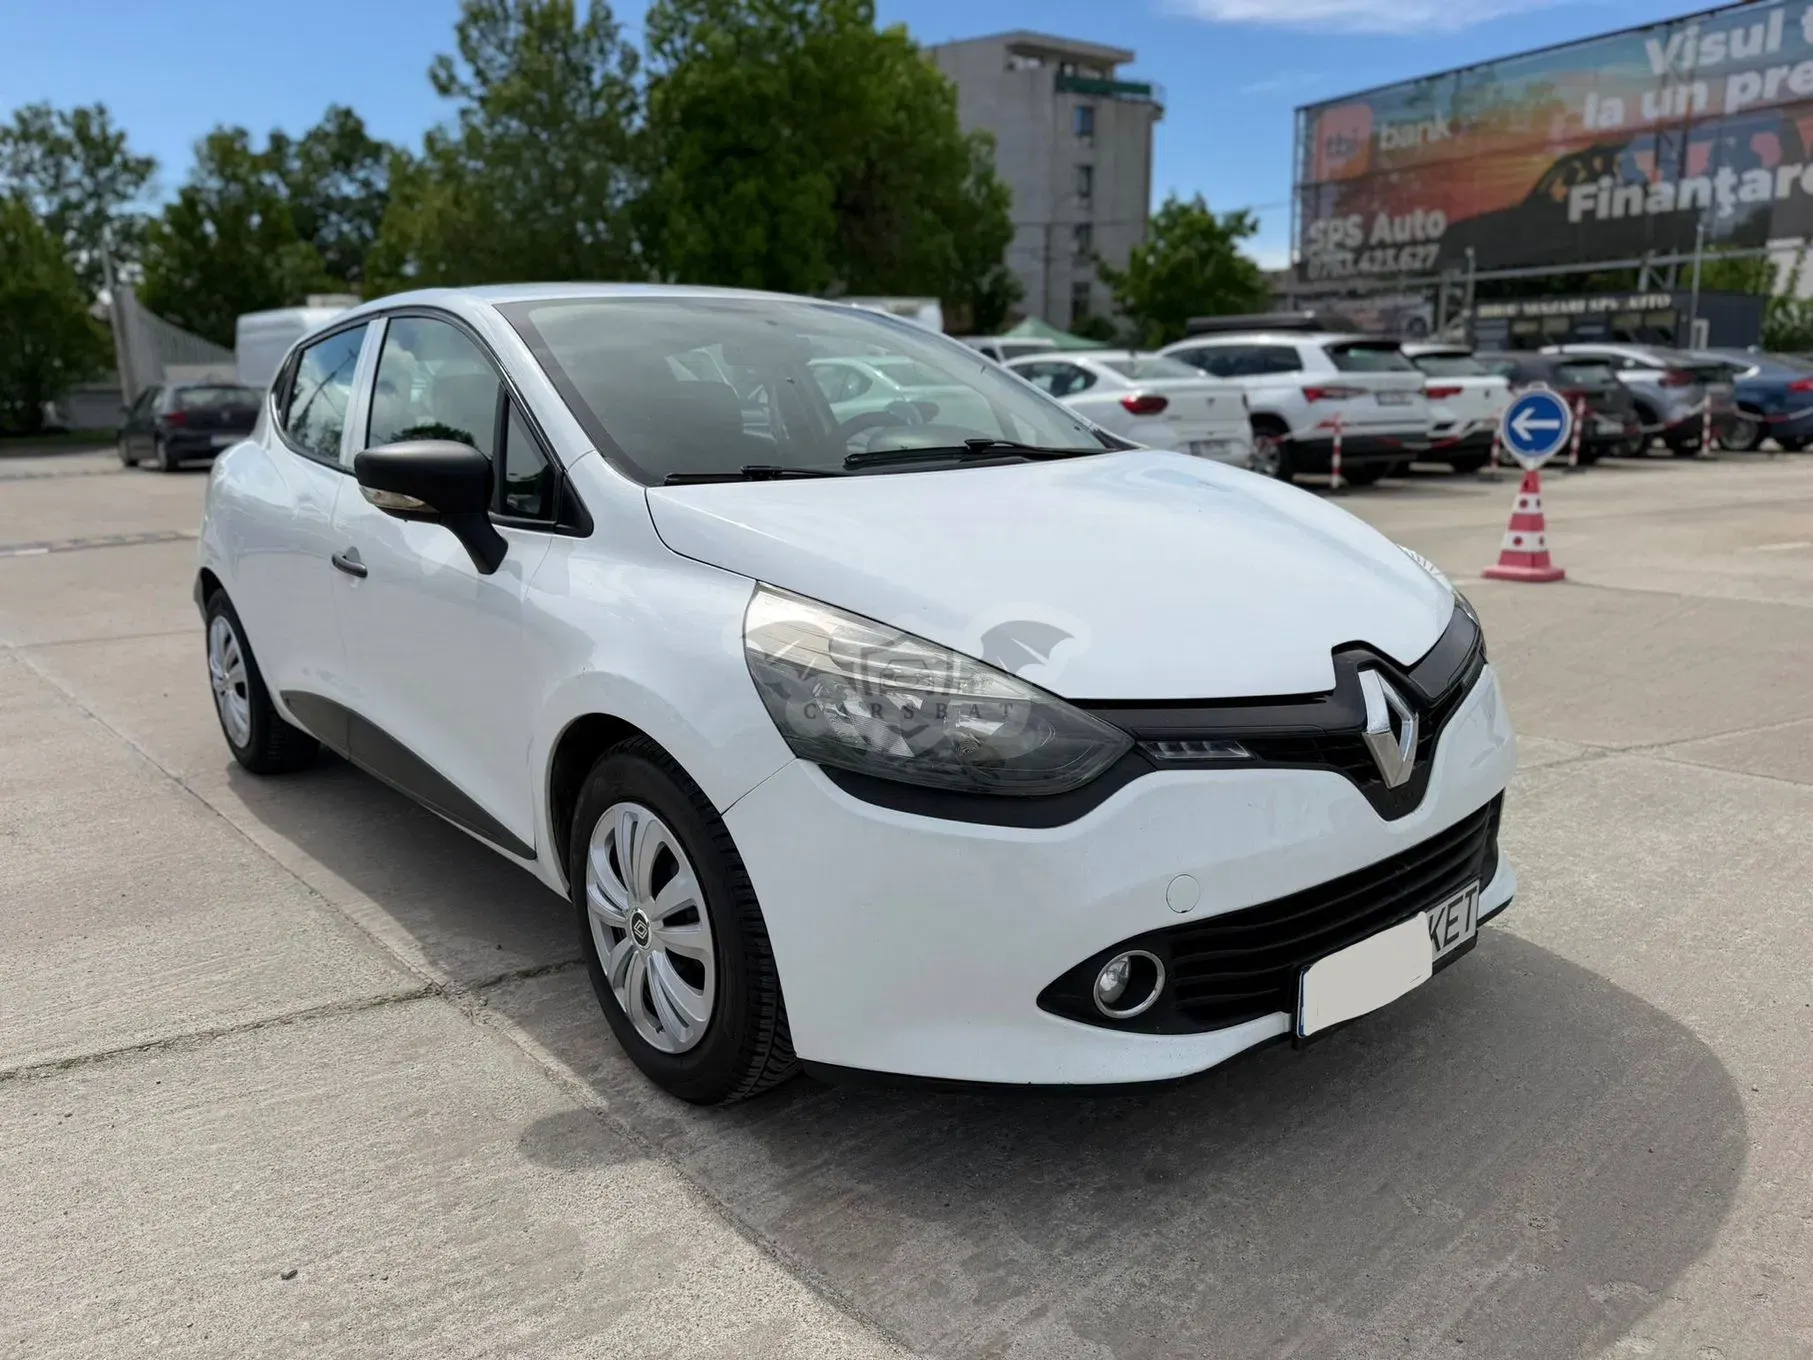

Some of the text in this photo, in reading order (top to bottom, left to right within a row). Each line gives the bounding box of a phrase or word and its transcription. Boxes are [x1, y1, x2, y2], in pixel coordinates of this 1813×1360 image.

[1645, 8, 1784, 75] Visul
[1584, 91, 1624, 130] la
[1642, 80, 1707, 120] un
[1379, 111, 1450, 152] bank
[1308, 207, 1447, 250] SPS Auto
